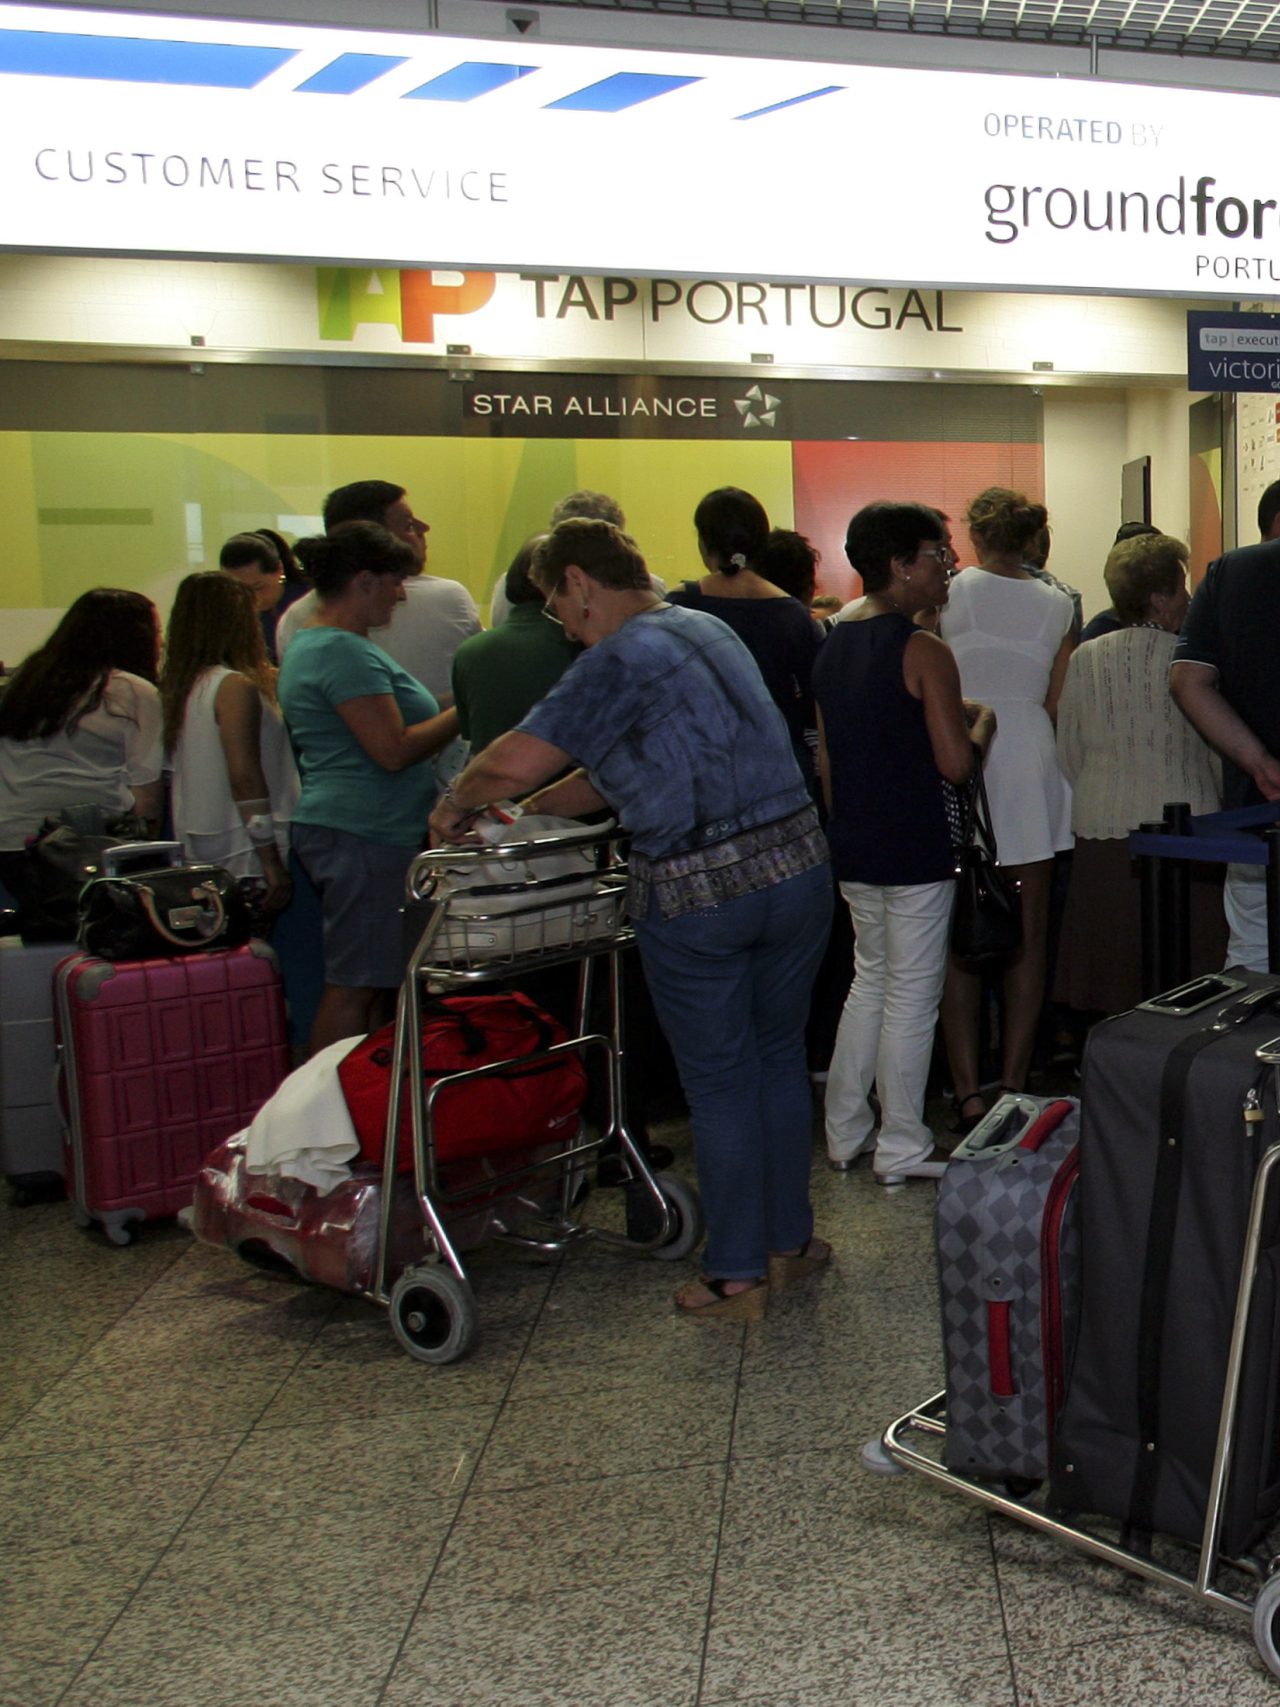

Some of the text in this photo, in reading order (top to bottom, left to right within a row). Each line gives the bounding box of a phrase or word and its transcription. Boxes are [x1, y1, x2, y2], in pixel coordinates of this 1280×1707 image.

[983, 112, 1164, 147] OPERATED BY
[35, 148, 508, 202] CUSTOMER SERVICE
[519, 272, 964, 333] TAP PORTUGAL
[1204, 333, 1228, 347] tap
[472, 393, 718, 418] STAR ALLIANCE
